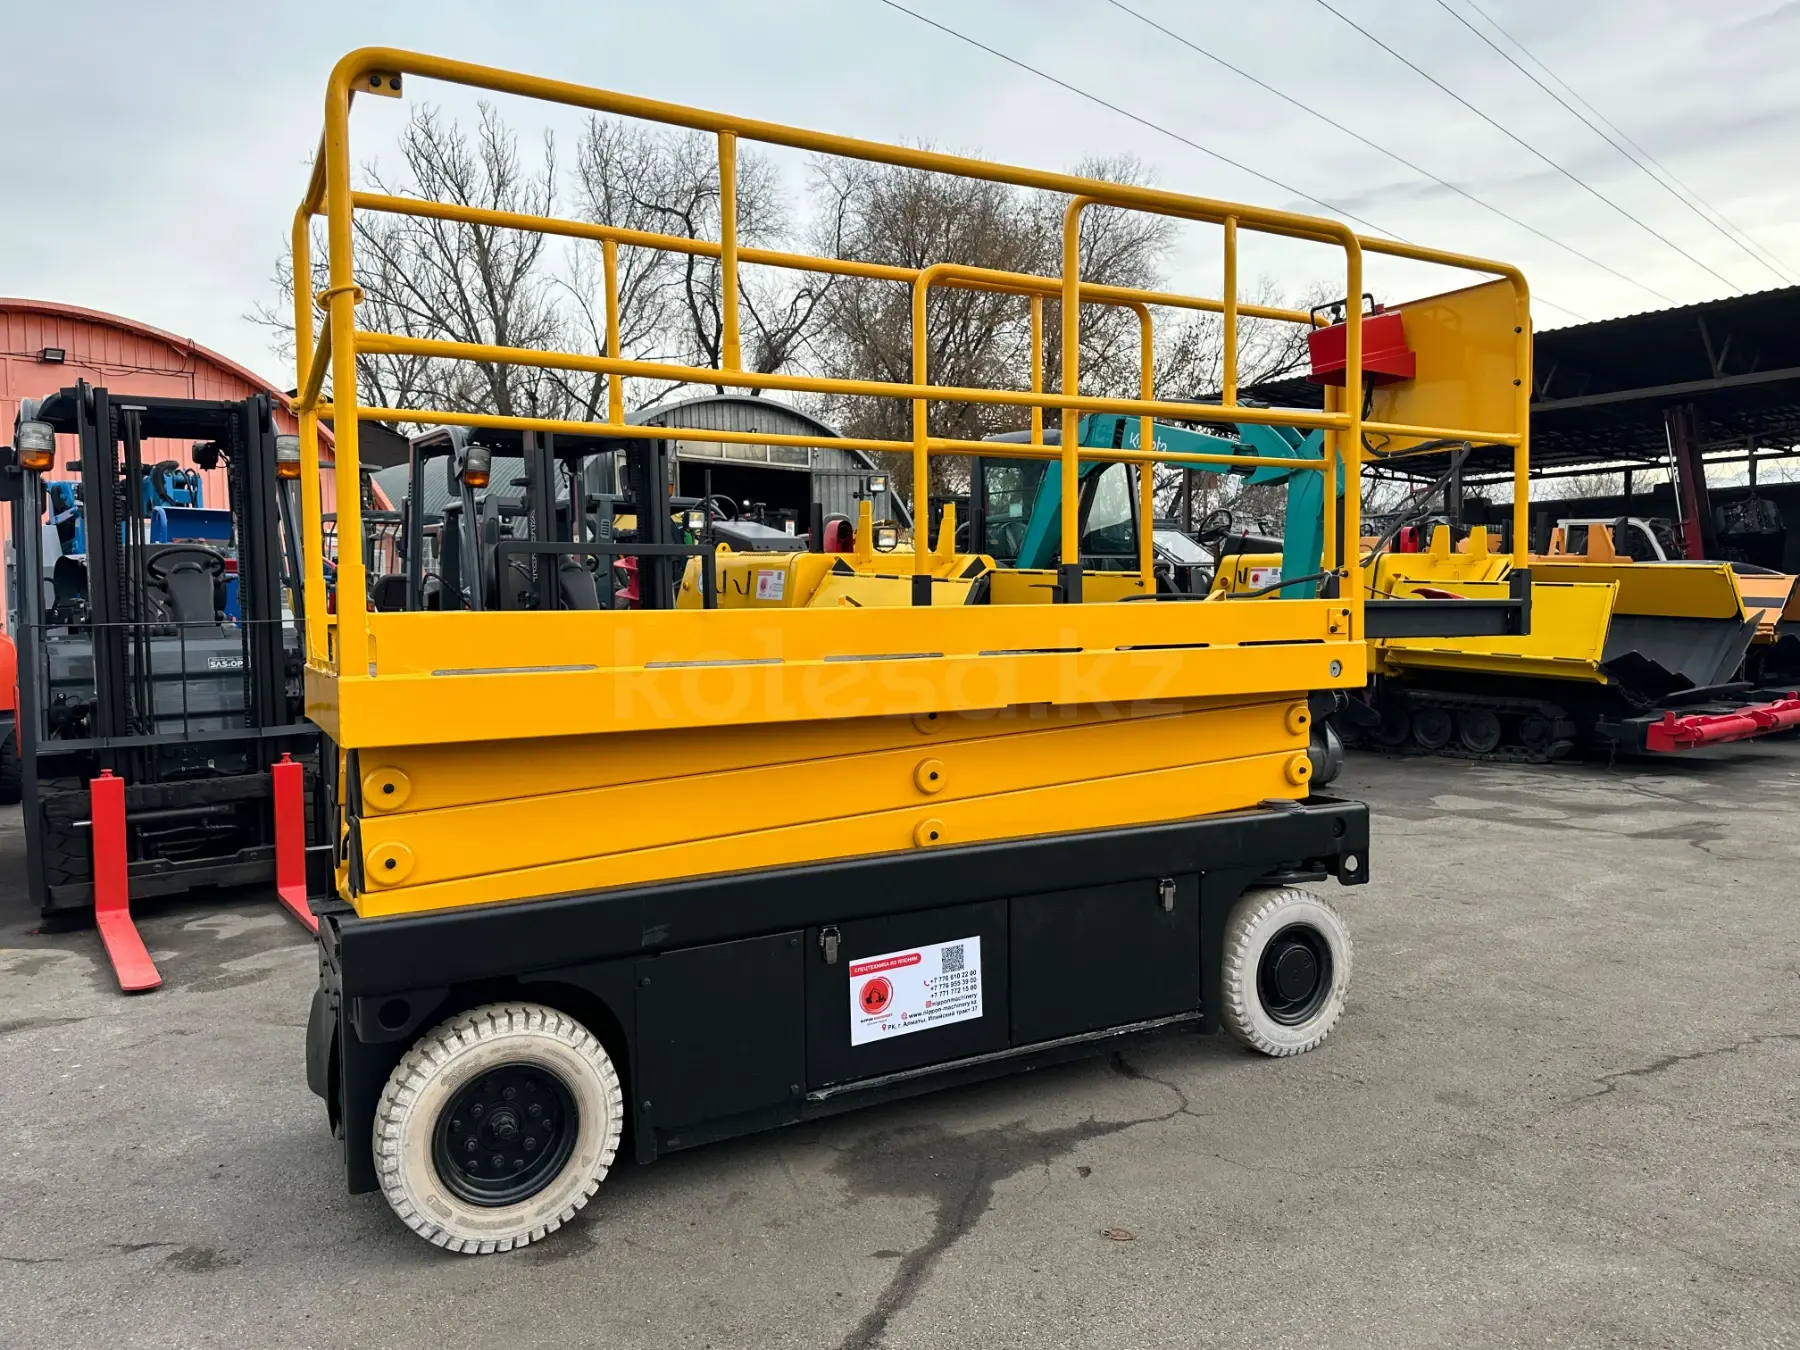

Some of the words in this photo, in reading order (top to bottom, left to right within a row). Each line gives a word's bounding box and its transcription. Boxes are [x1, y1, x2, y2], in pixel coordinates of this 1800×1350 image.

[1129, 432, 1167, 452] Kota
[530, 509, 538, 583] TOOTA
[854, 962, 890, 973] СПЕЦТЕХНИКА
